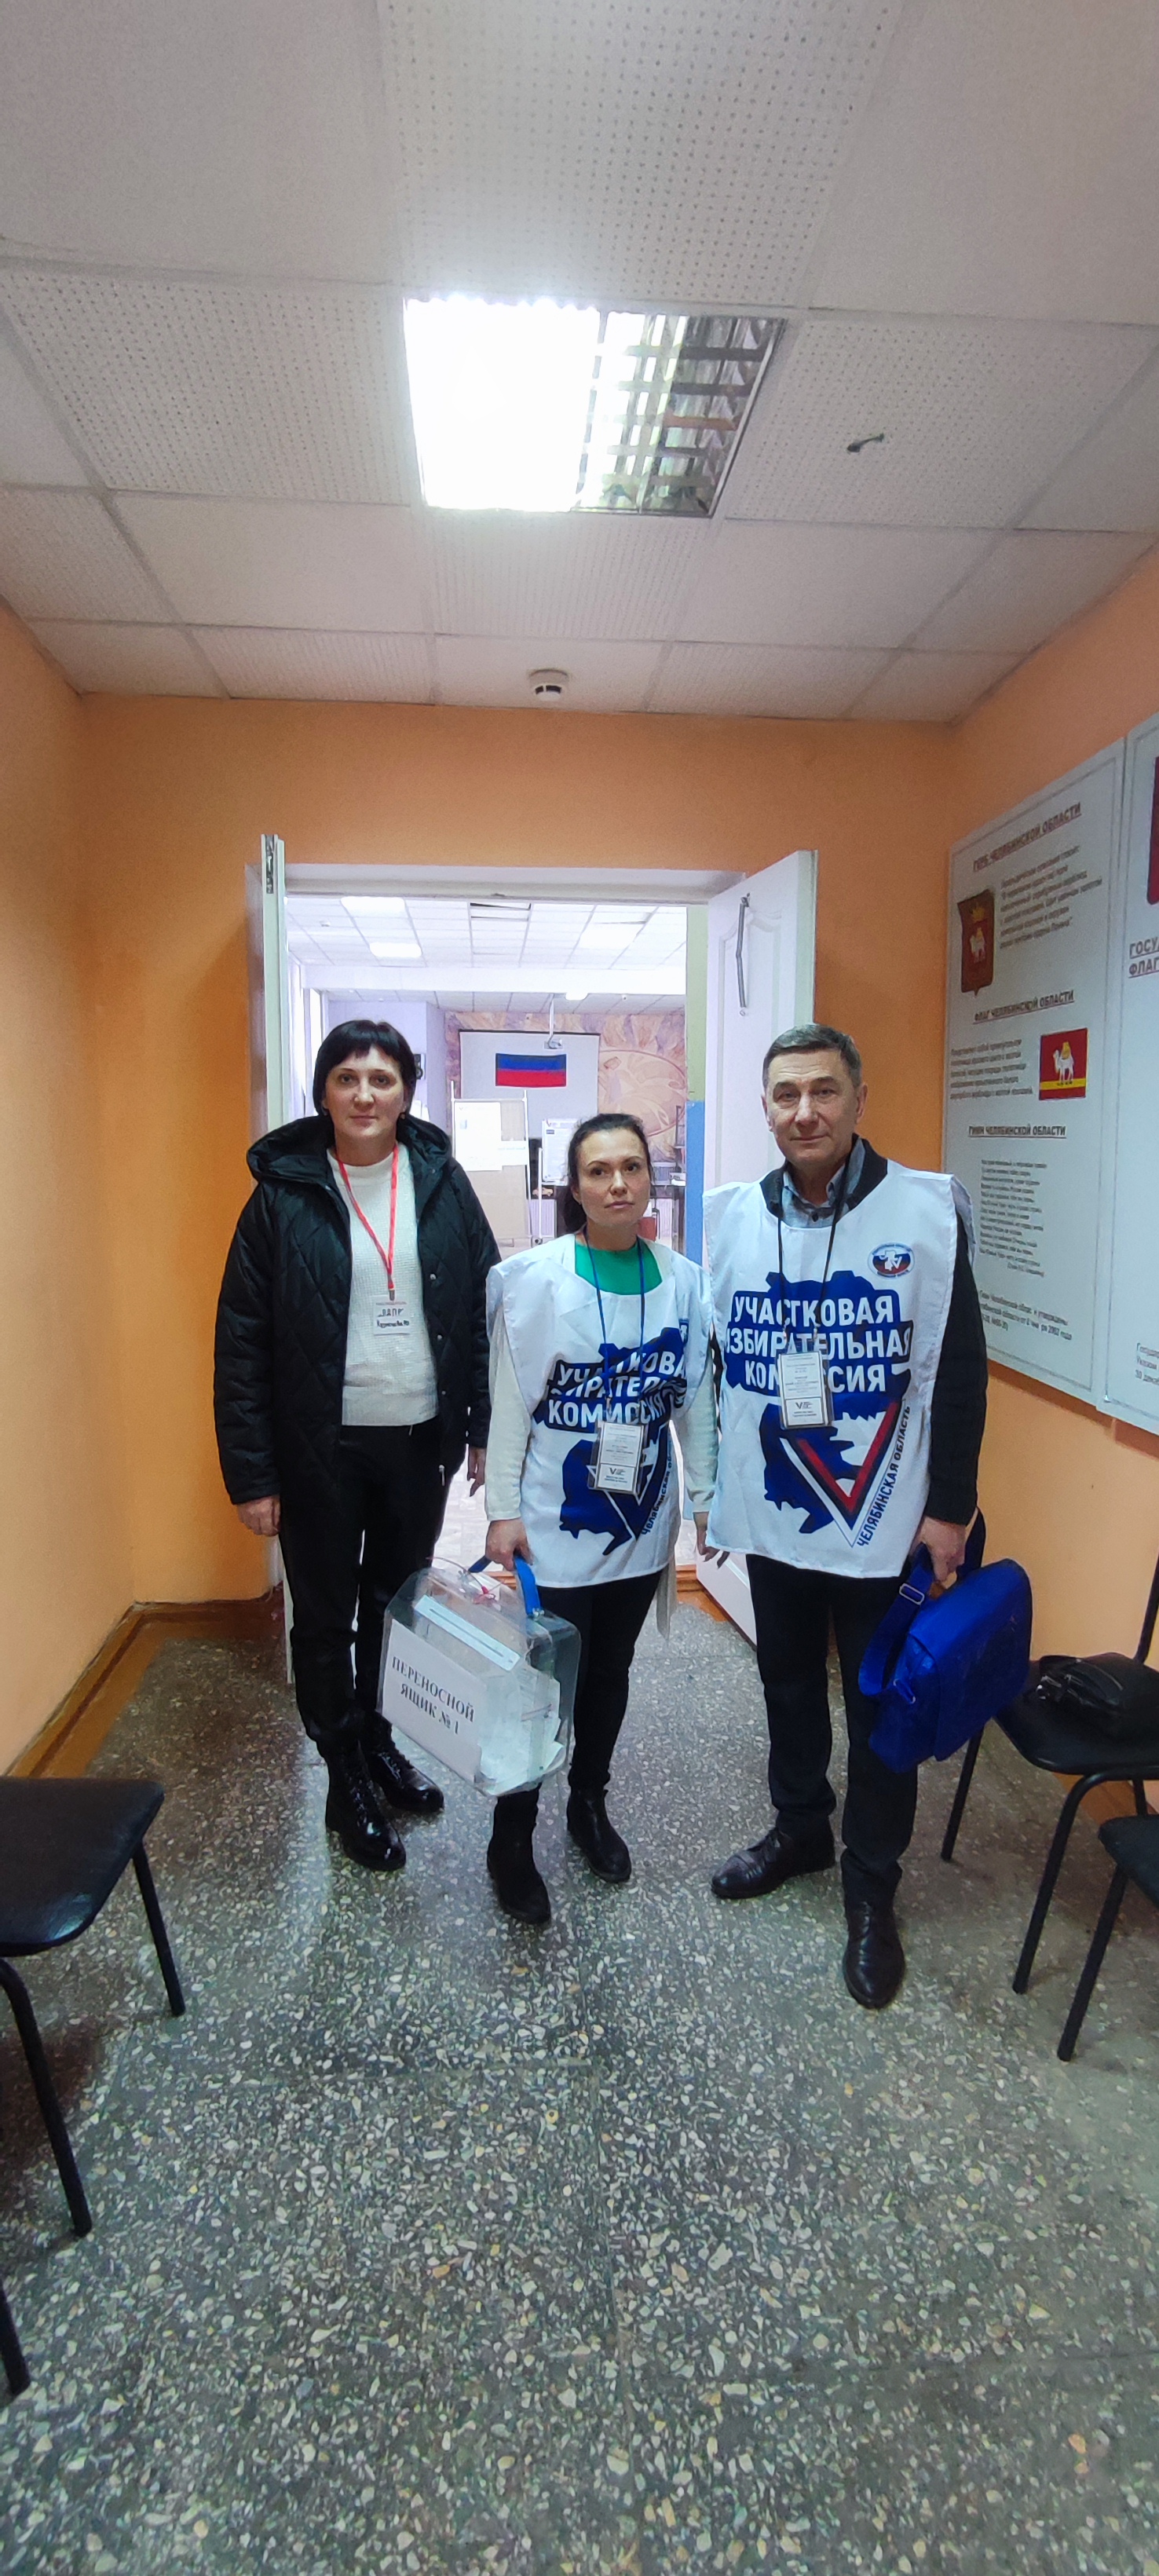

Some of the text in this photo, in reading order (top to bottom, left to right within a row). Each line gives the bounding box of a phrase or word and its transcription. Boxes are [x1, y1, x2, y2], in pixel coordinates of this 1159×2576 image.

[1042, 802, 1081, 833] ОБЛАСТИ
[1129, 936, 1159, 956] ГОСУ
[1129, 957, 1159, 976] ФЛАГ
[1040, 990, 1074, 1007] ОБЛАСТИ
[985, 1124, 1031, 1136] ЧЕЛЯБИНСКОЙ
[1033, 1125, 1066, 1136] ОБЛАСТИ
[735, 1296, 894, 1326] УЧАСТКОВАЯ
[745, 1361, 886, 1392] КОСИЯ
[857, 1406, 910, 1546] ЧЕЛЯБИНСКАЯ ОБЛАСТЬ
[393, 1656, 474, 1722] ПЕРЕНОСНОЙ
[400, 1684, 437, 1718] ЯЩИК
[439, 1711, 451, 1729] №
